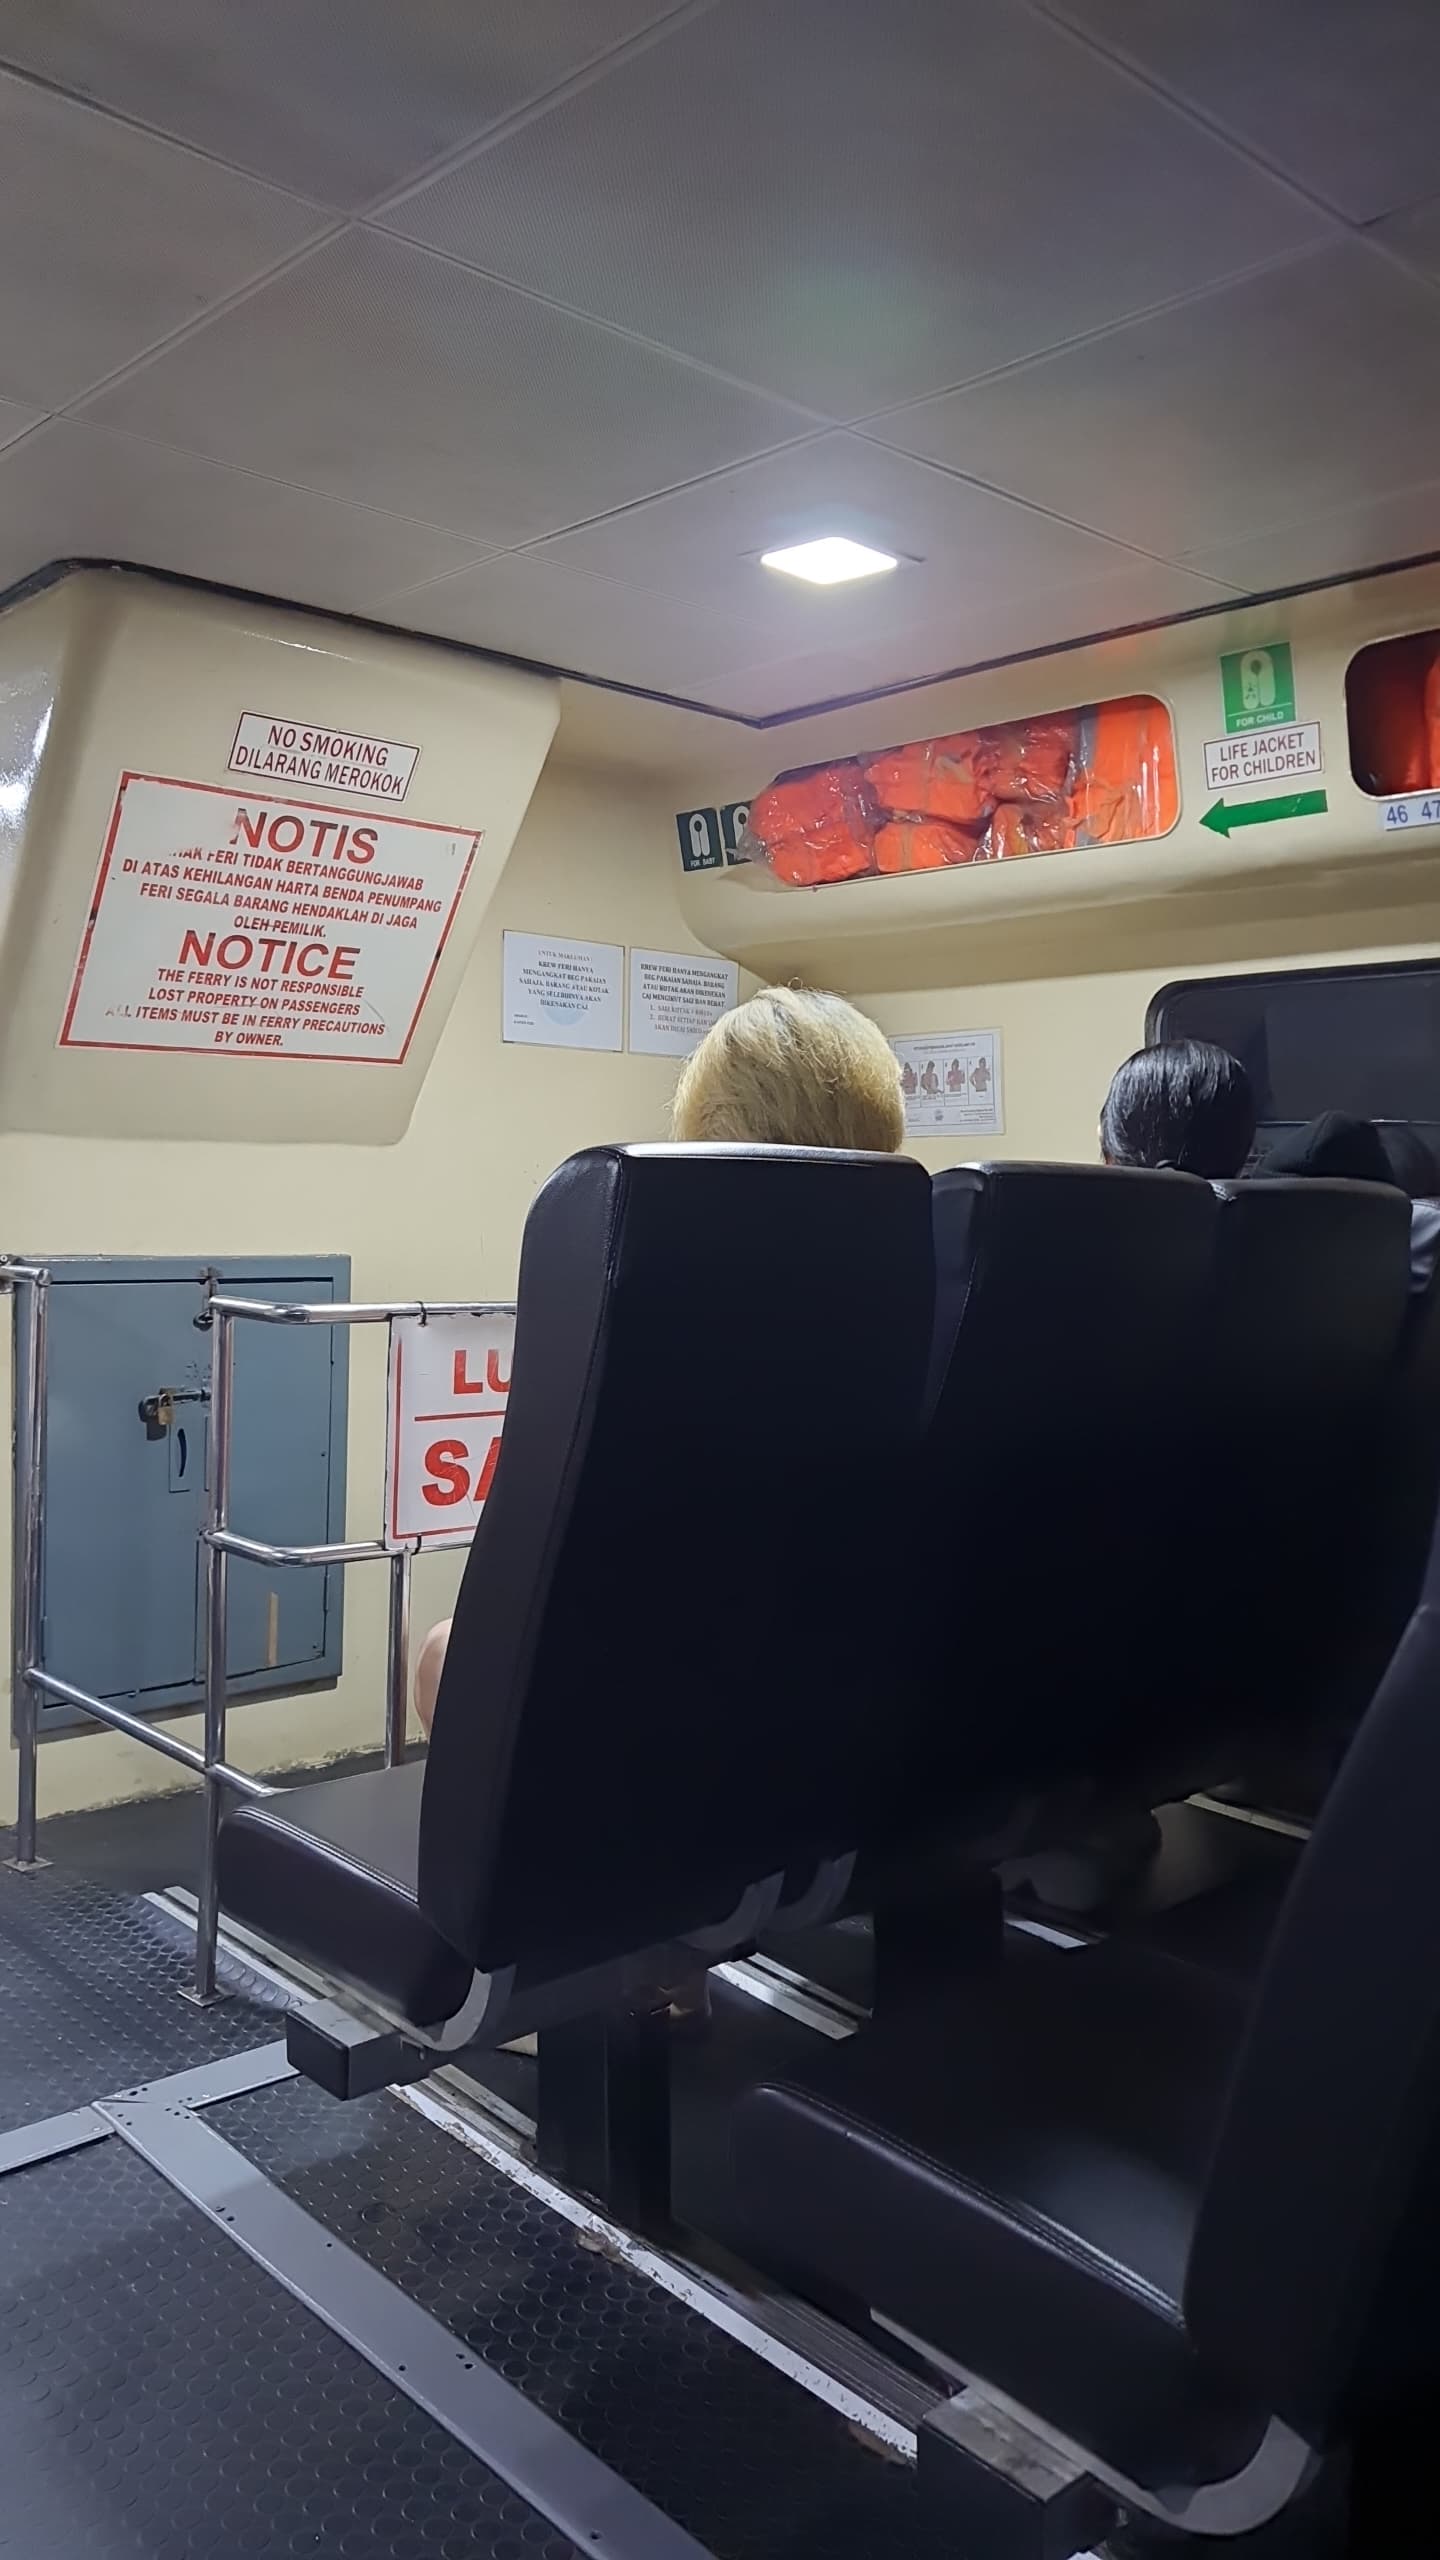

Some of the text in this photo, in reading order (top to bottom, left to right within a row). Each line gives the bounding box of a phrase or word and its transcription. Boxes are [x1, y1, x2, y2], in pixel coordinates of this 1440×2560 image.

[1236, 711, 1285, 728] FOR CHILD
[267, 725, 389, 767] NO SMOKING
[1220, 731, 1305, 762] LIFE JACKET
[235, 746, 404, 795] DILARANG MEROKOK
[1211, 750, 1316, 783] FOR CHILDREN
[1386, 801, 1440, 825] 46 47
[229, 807, 379, 864] NOTIS
[122, 859, 442, 913] DI ATAS KEHILANGAN HARTA BENDA PENUMPANG
[243, 853, 283, 872] TIDAK
[286, 860, 424, 891] BERTANGGUNGJAWAB
[140, 882, 418, 929] FERI SEGALA BARANG HENDAKLAH DI JAGA
[234, 915, 327, 938] OLEH PEMILIK.
[178, 929, 361, 980] NOTICE
[157, 968, 365, 998] THE FERRY IS NOT RESPONSIBLE
[148, 987, 361, 1016] LOST PROPERTY ON PASSENGERS
[135, 1006, 178, 1021] ITEMS
[180, 1009, 220, 1024] MUST
[221, 1012, 240, 1026] BE
[242, 1014, 257, 1027] IN
[259, 1015, 301, 1030] FERRY
[302, 1018, 386, 1036] PRECAUTIONS
[214, 1030, 284, 1046] BY OWNER.
